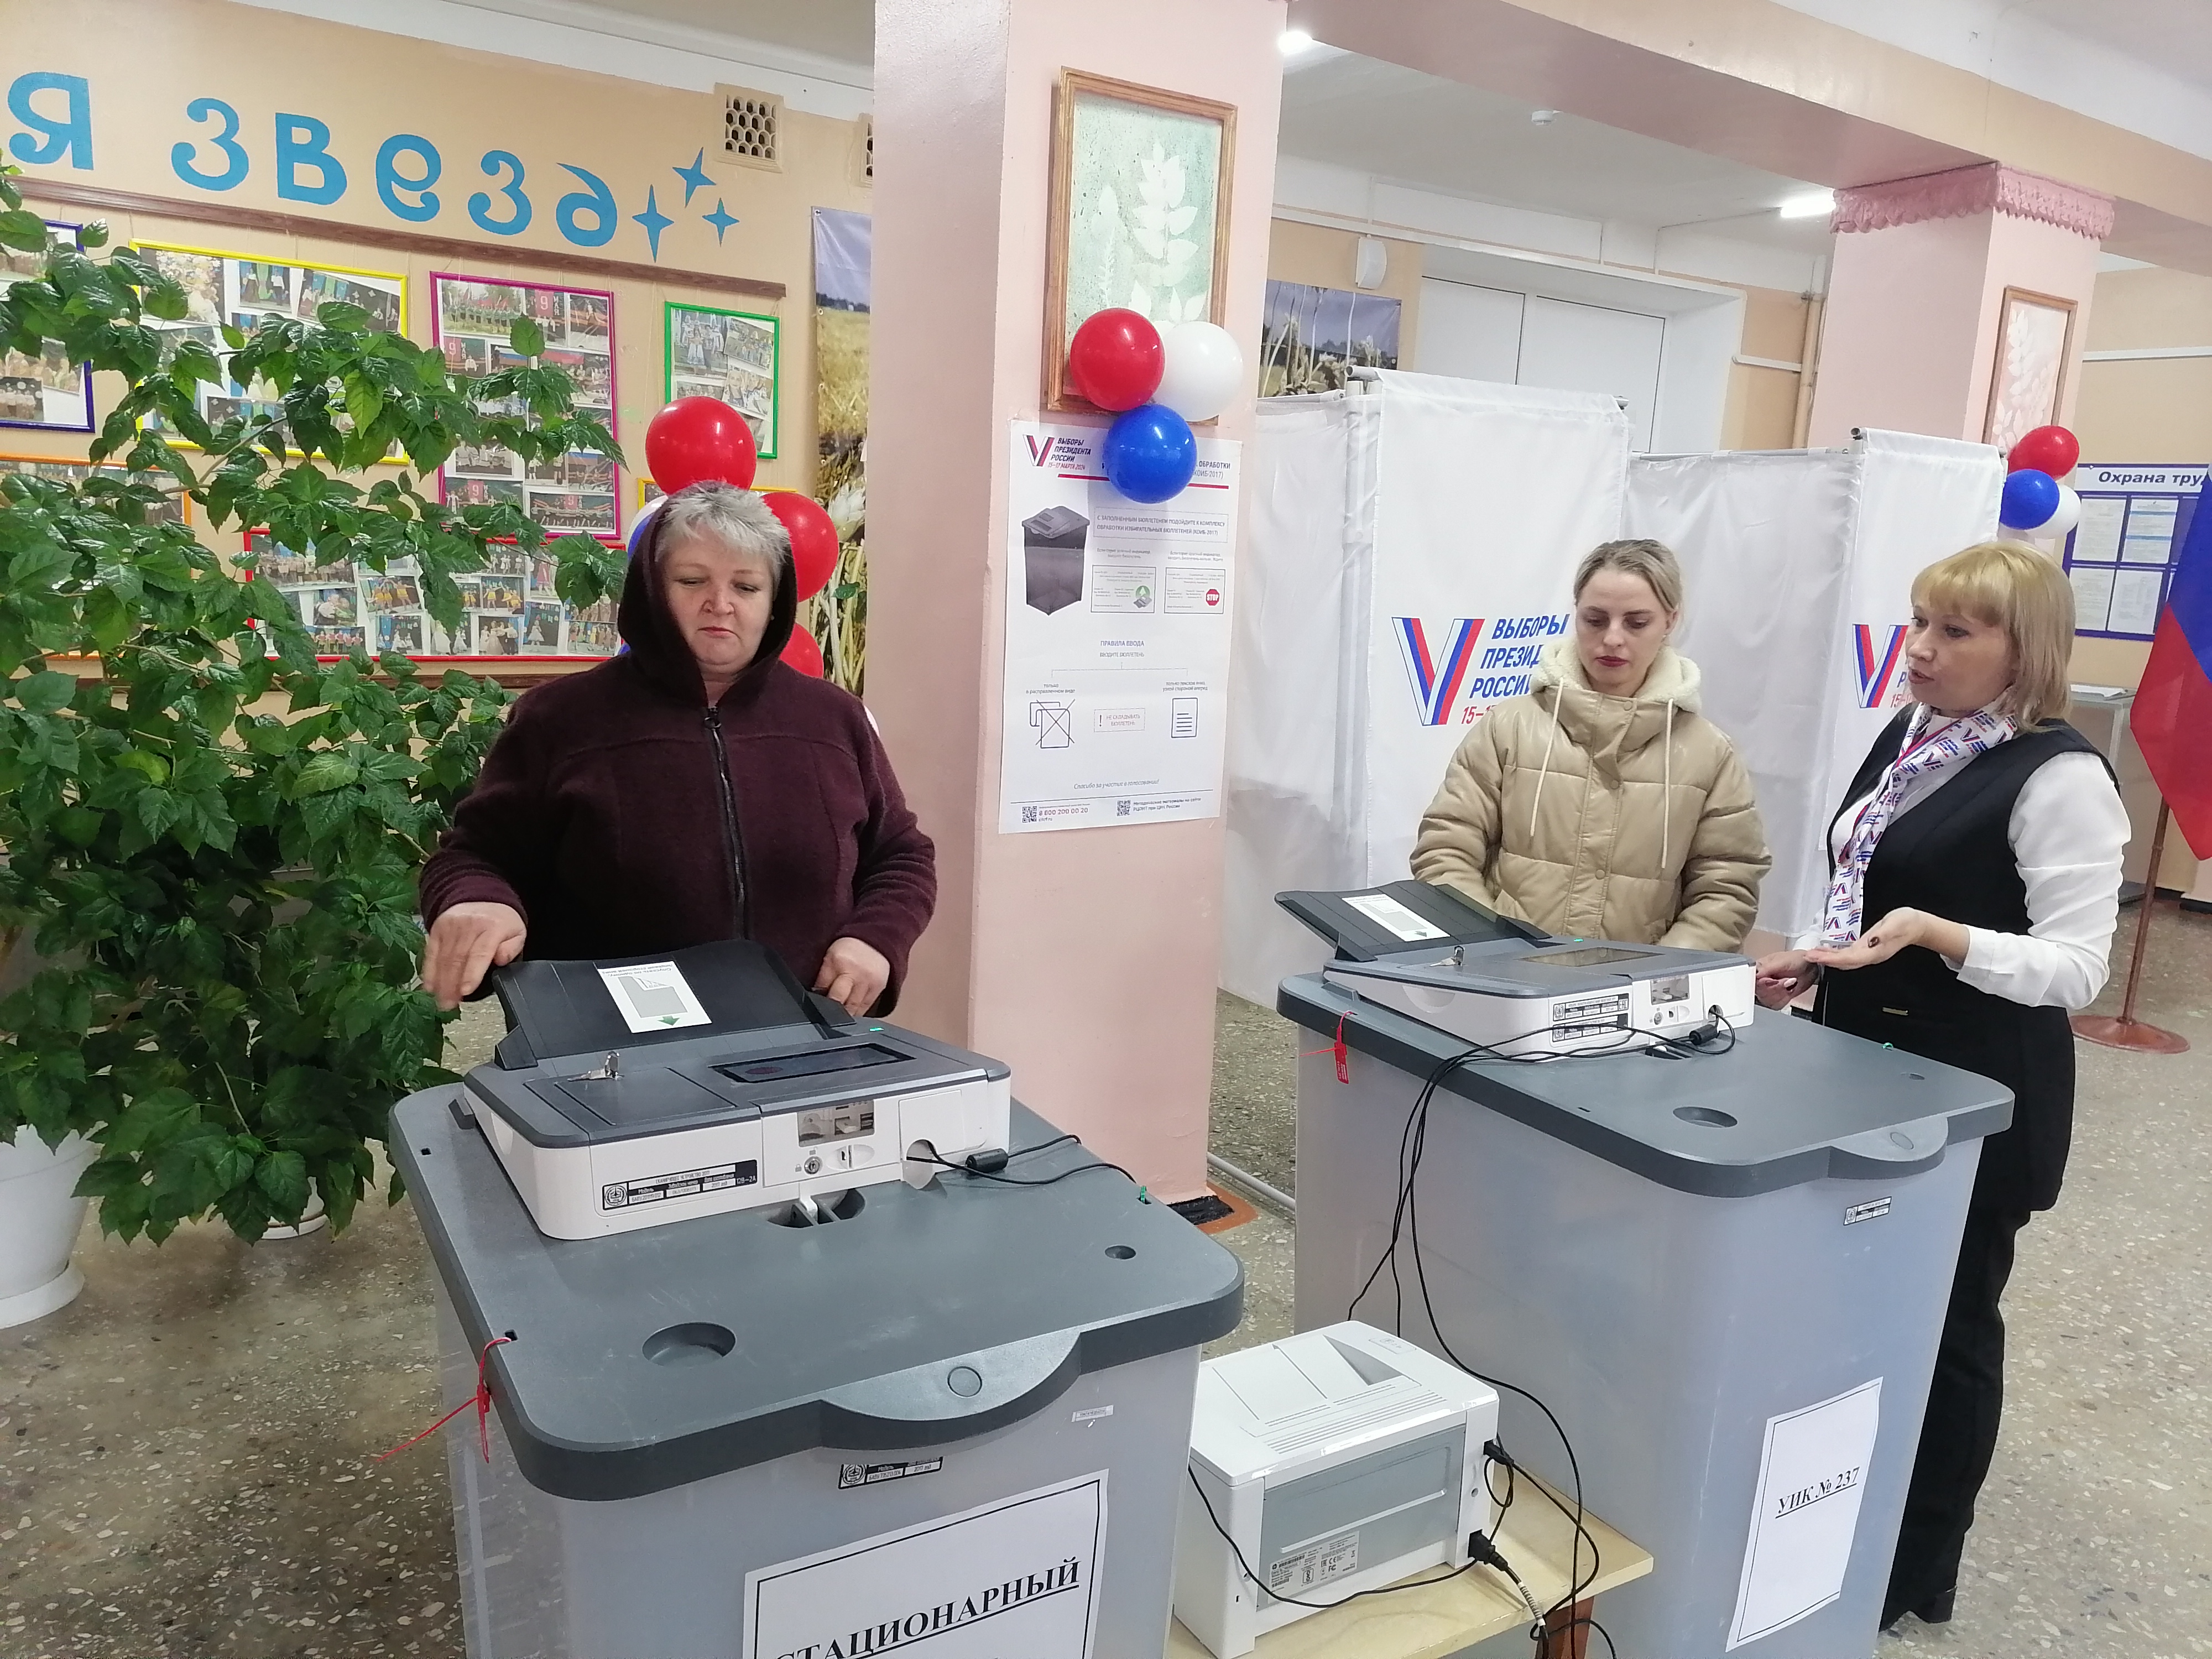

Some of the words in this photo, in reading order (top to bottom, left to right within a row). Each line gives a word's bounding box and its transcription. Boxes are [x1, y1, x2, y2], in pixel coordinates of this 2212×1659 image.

[1057, 437, 1084, 446] ВЫБОРЫ
[1054, 446, 1091, 455] ПРЕЗИДЕНТА
[1199, 461, 1230, 469] ОБРАБОТКИ
[1193, 469, 1224, 479] КОИБ-2017)
[2099, 471, 2166, 486] Охрана
[2172, 474, 2204, 487] тру
[1491, 613, 1571, 640] ВЫБОРЫ
[1480, 644, 1544, 669] ПРЕЗИД
[1777, 1485, 1814, 1515] УИК
[1815, 1478, 1832, 1499] №
[1834, 1466, 1860, 1491] 237
[775, 1555, 1082, 1659] ТАЦИОНАРНЫЙ
